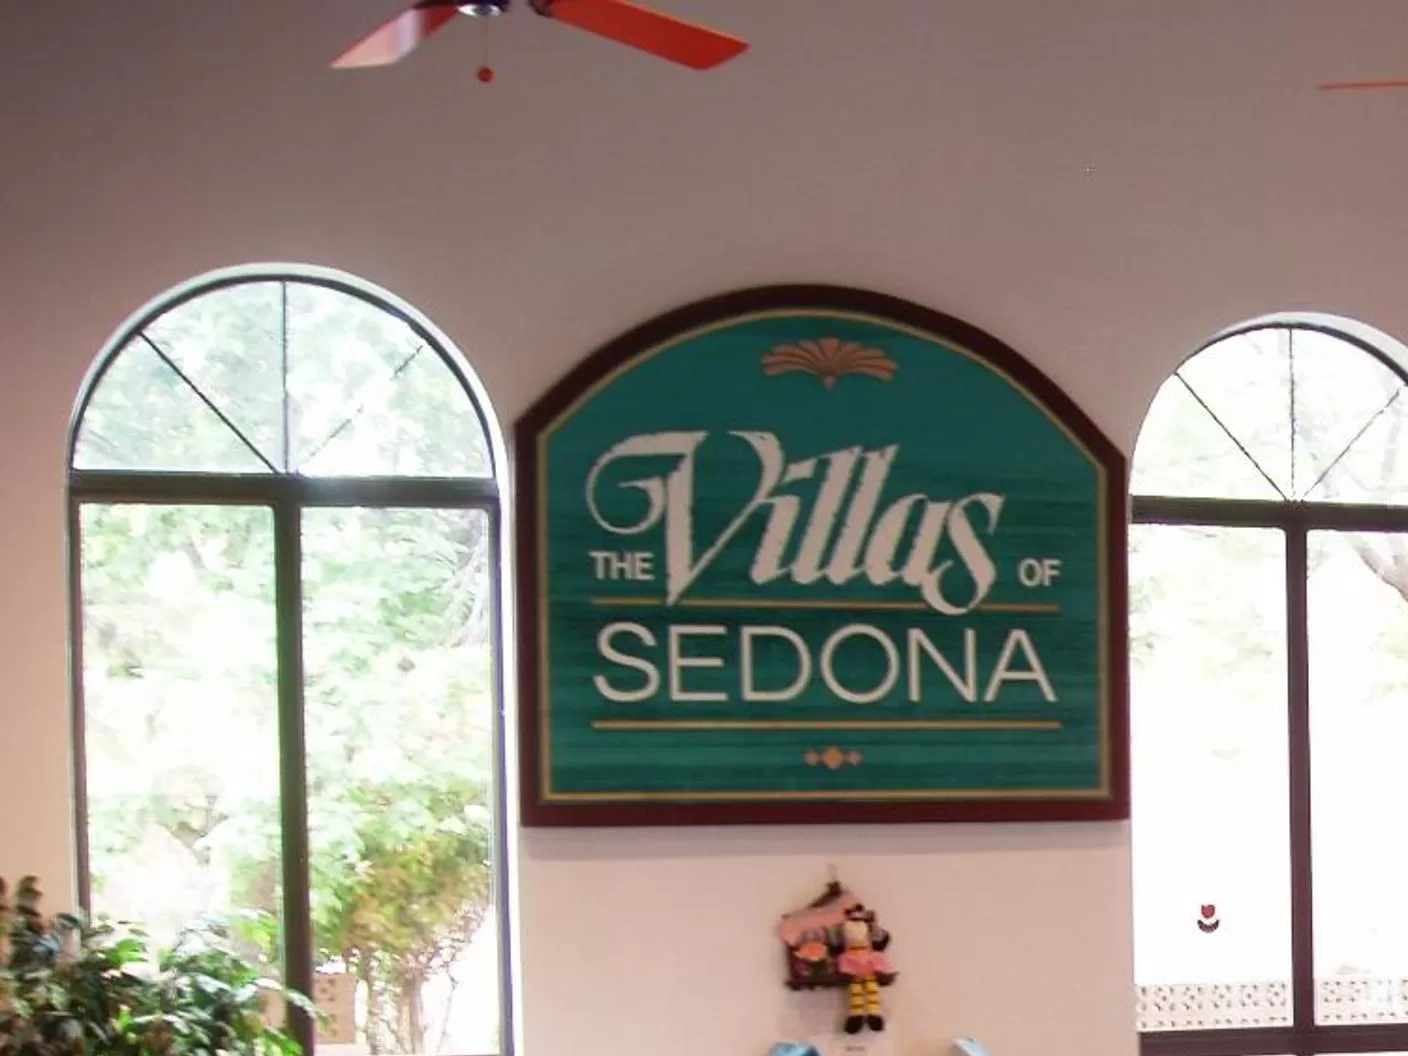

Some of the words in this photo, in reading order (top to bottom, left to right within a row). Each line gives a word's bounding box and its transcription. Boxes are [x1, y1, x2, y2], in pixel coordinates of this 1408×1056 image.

[586, 430, 1006, 615] Villas
[590, 551, 654, 581] THE
[1018, 558, 1061, 587] OF
[593, 622, 1057, 704] SEDONA
